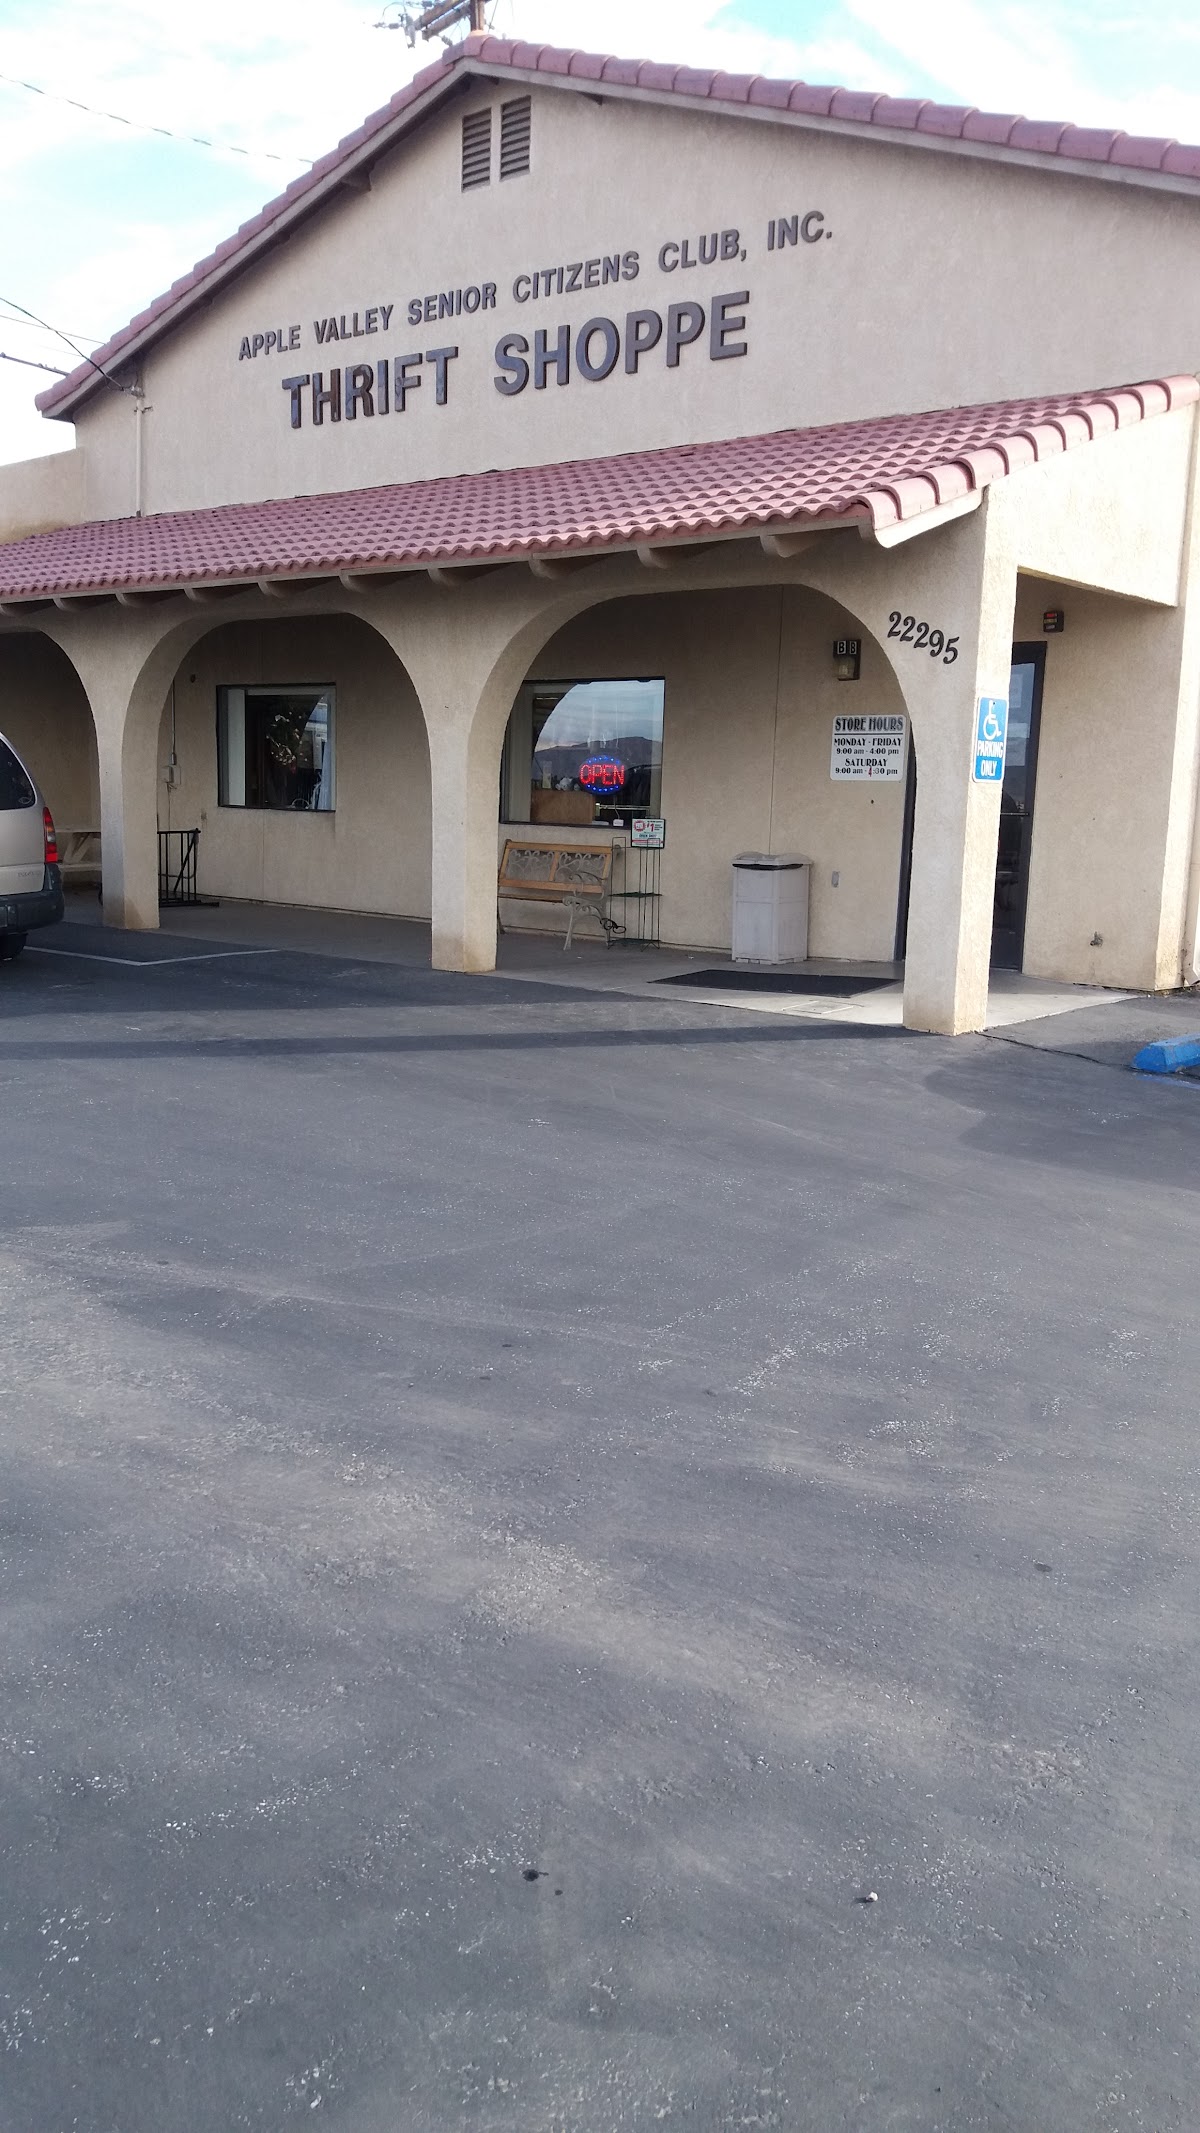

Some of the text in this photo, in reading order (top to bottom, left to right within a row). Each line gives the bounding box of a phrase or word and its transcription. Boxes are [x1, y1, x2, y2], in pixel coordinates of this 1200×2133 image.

[238, 210, 833, 361] APPLE VALLEY SENIOR CITIZENS CLUB, INC.
[281, 290, 750, 429] THRIFT SHOPPE
[887, 611, 960, 665] 22295
[835, 716, 904, 732] STORE HOURS
[834, 738, 866, 747] MONDAY
[872, 738, 903, 747] FRIDAY
[977, 740, 1003, 758] PARKING
[887, 748, 899, 756] pm
[845, 758, 888, 767] SATURDAY
[980, 760, 997, 776] ONLY
[580, 764, 625, 785] OPEN
